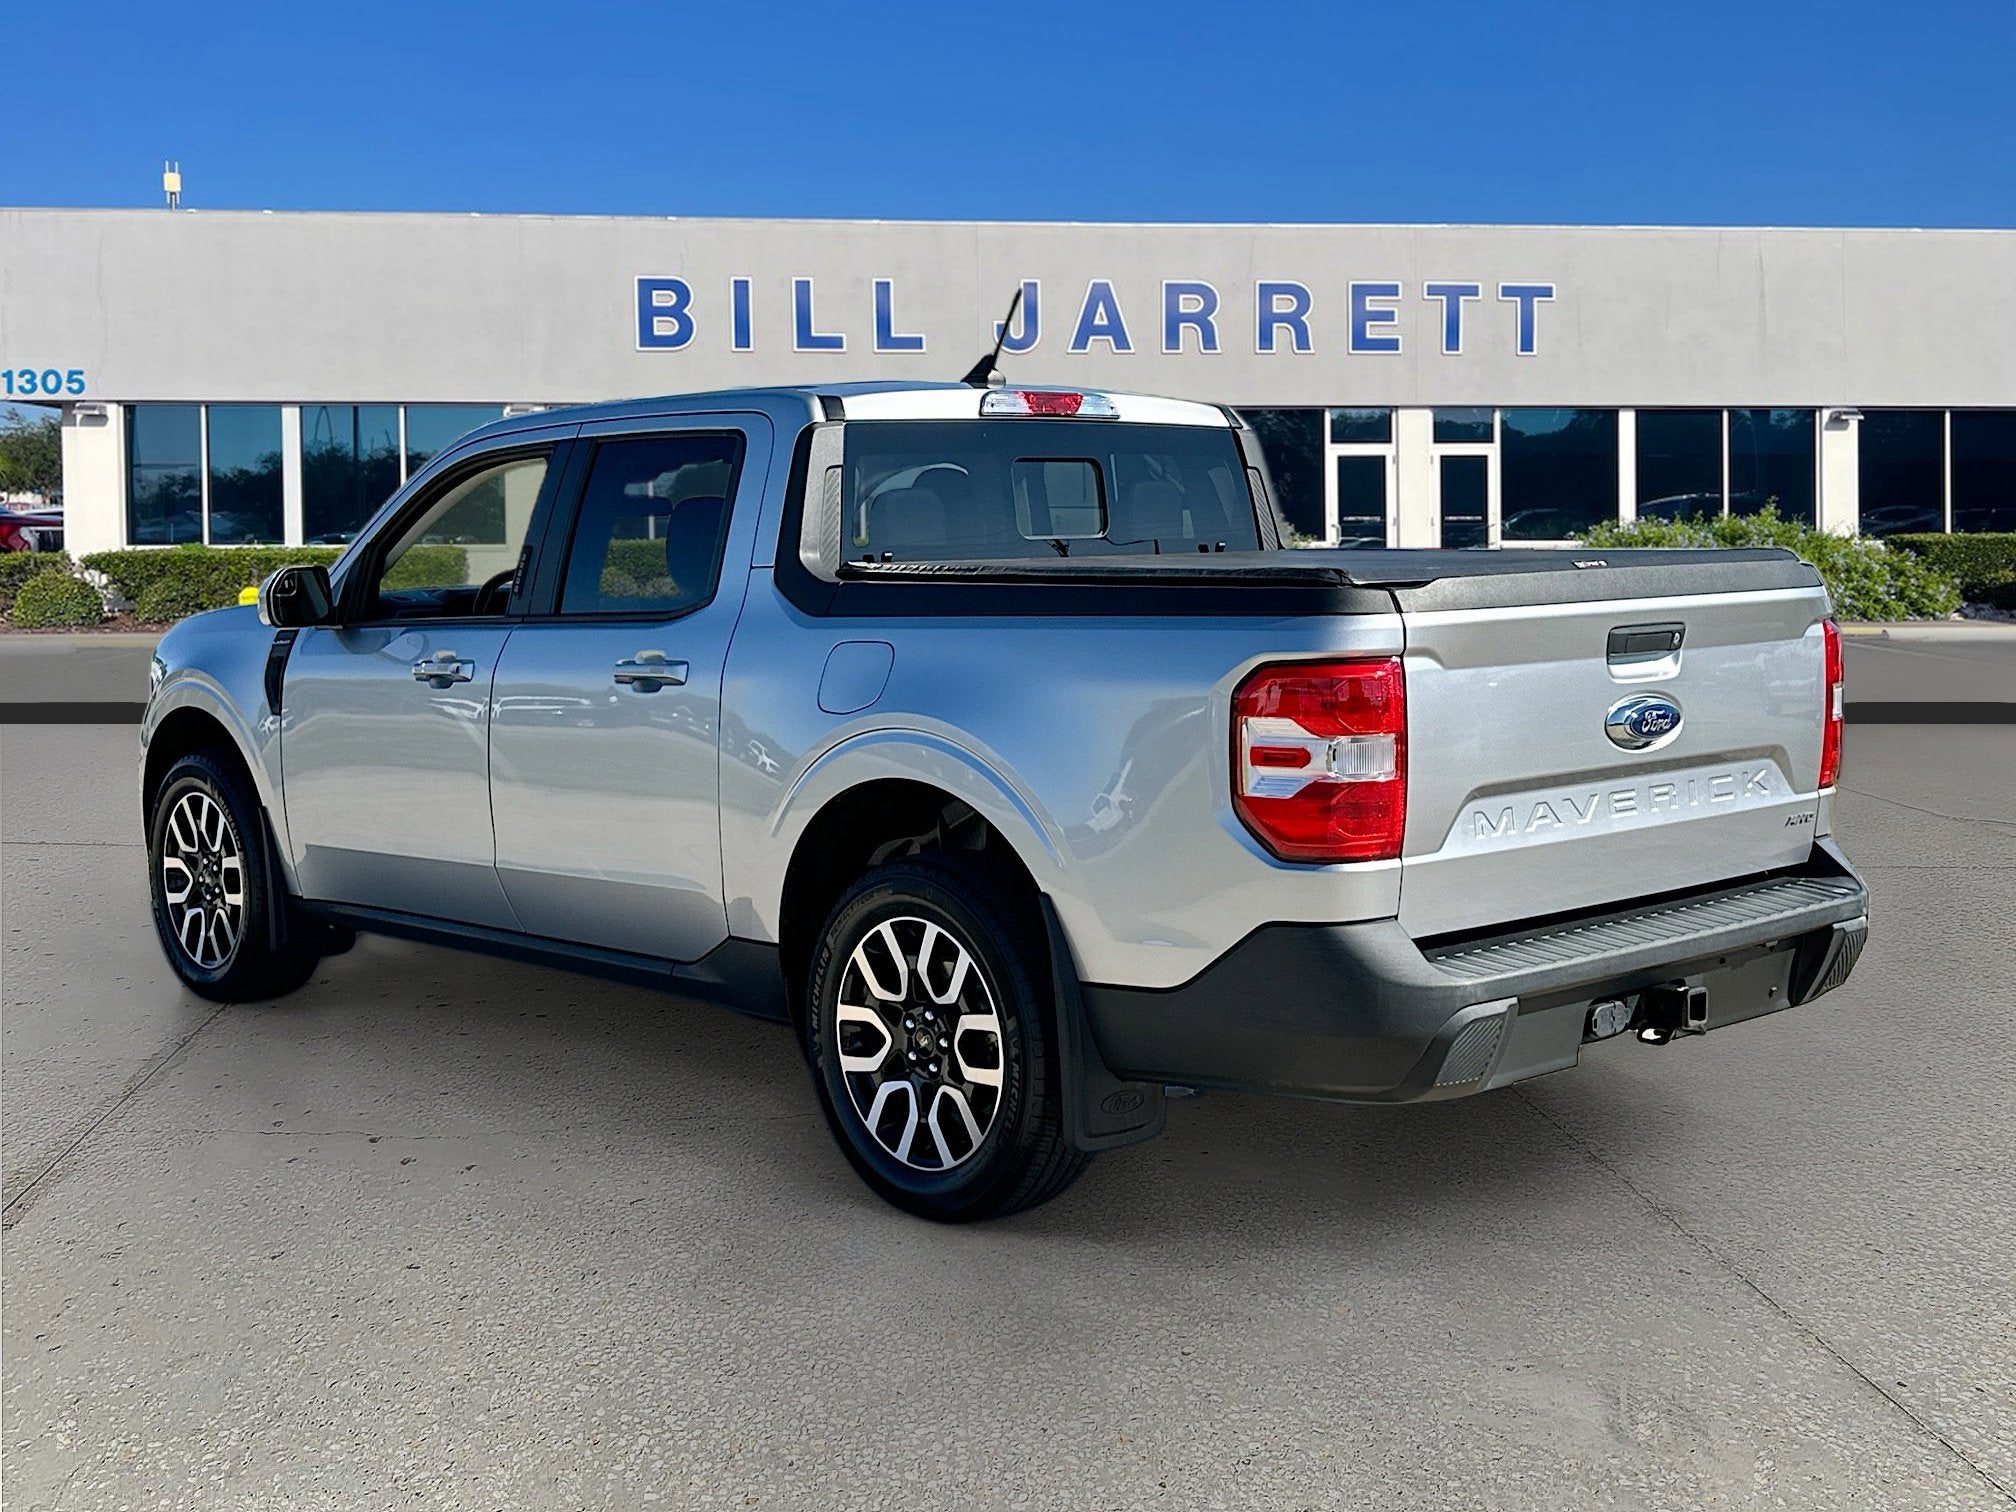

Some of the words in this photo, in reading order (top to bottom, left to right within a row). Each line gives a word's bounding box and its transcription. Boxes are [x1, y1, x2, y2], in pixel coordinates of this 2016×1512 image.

[634, 274, 926, 354] BILL
[992, 279, 1556, 357] JARRETT
[1, 369, 86, 395] 1305
[1641, 709, 1673, 733] Ford
[1473, 768, 1772, 840] MAVERICK
[810, 944, 832, 1030] MICHELIN
